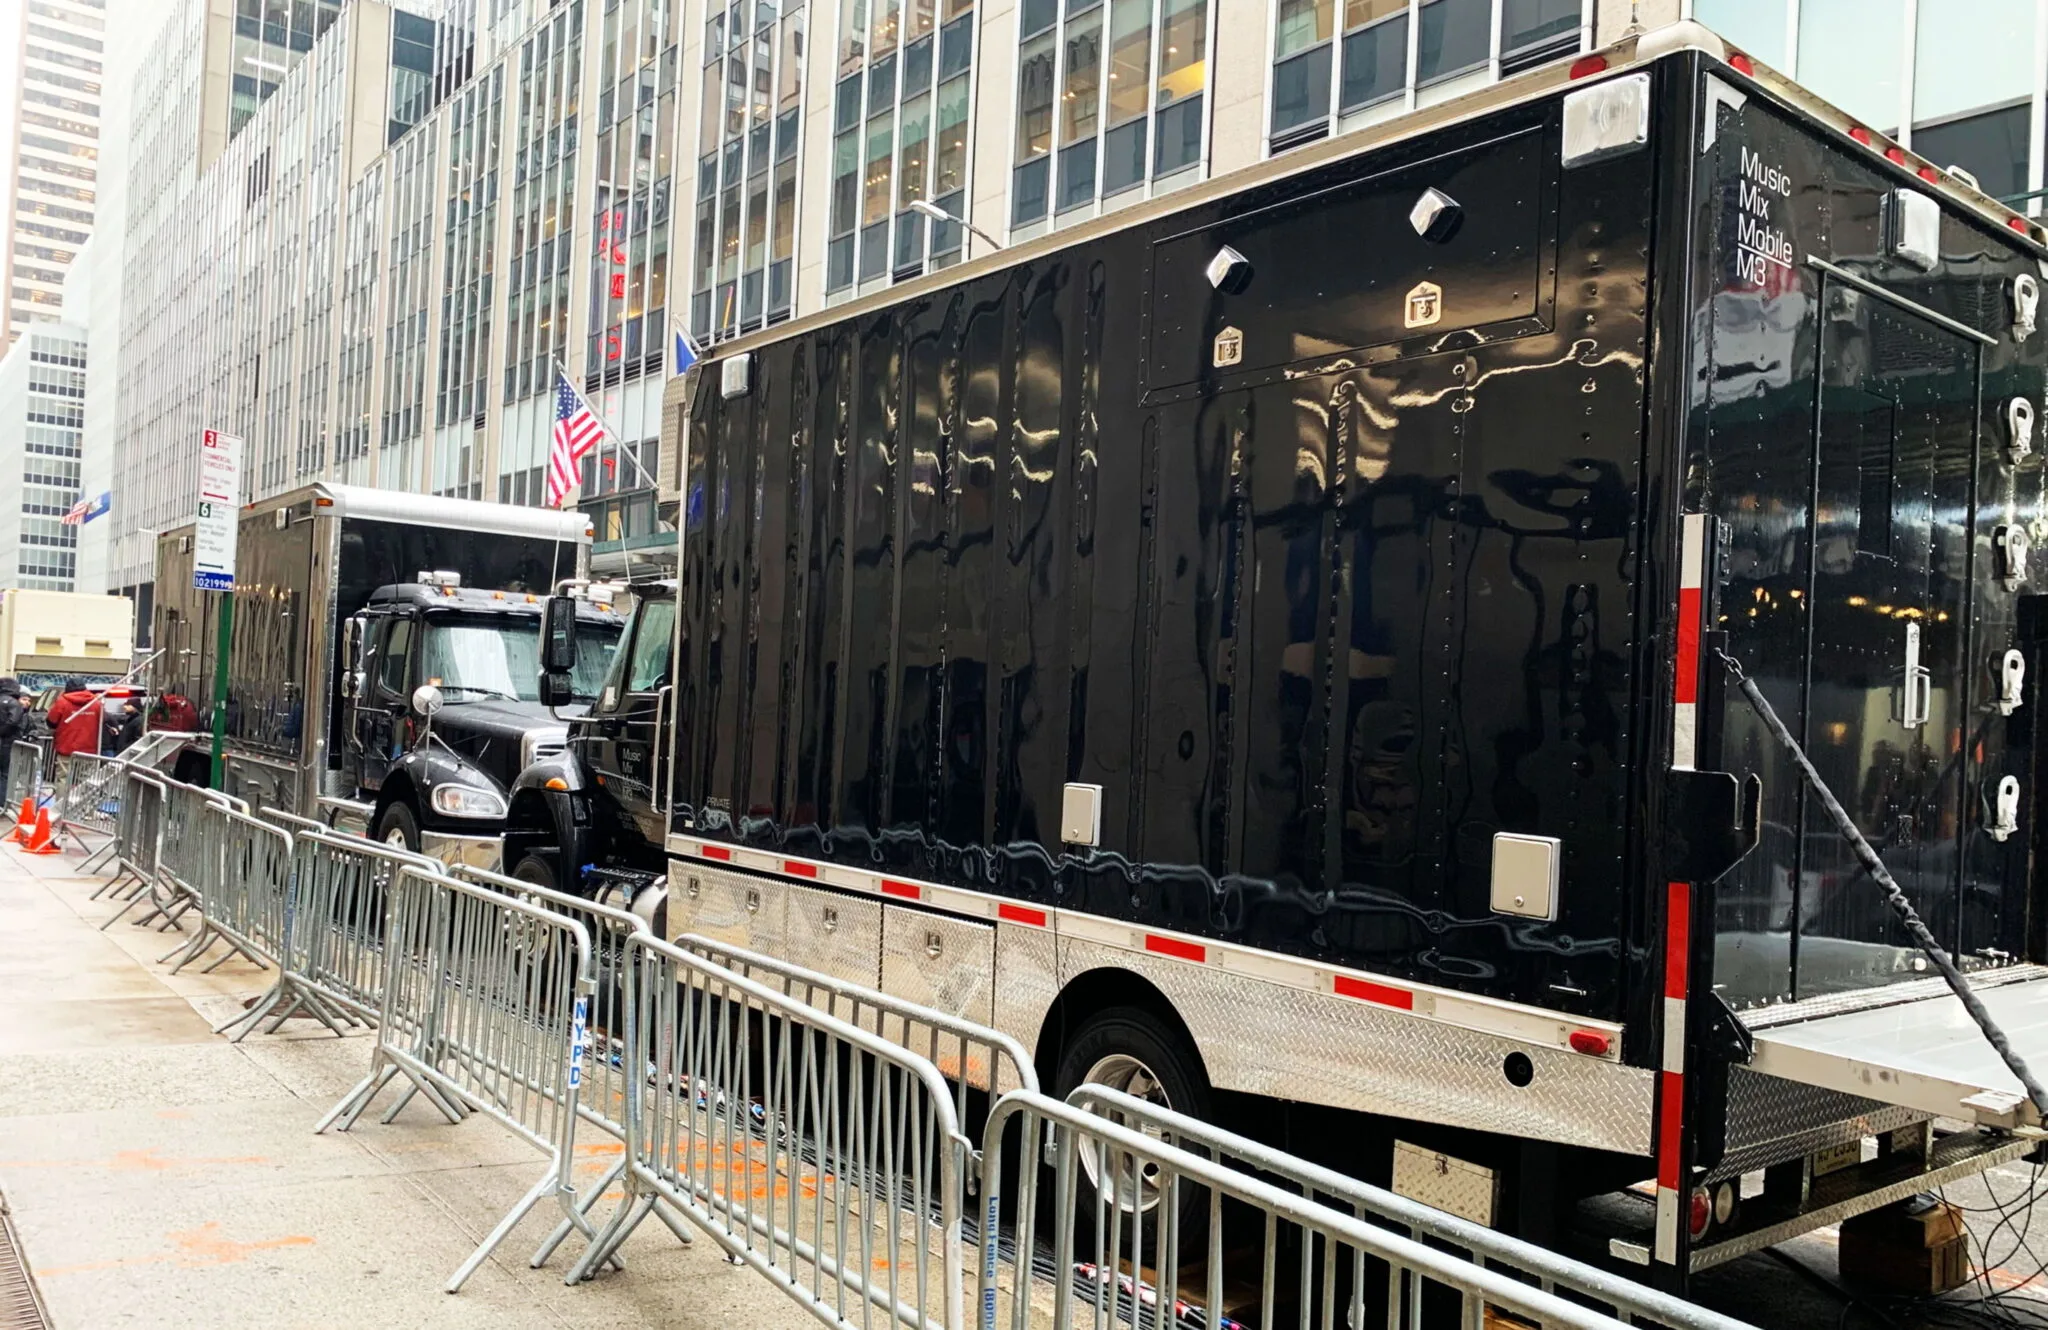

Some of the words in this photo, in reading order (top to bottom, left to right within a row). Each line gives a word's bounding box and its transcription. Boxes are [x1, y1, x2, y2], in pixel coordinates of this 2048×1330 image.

[1740, 145, 1791, 197] Music
[1739, 179, 1770, 221] Mix
[1737, 212, 1793, 264] Mobile
[1736, 248, 1766, 287] M3
[206, 431, 215, 448] 3
[200, 502, 209, 517] 6
[195, 577, 225, 589] 102199
[622, 747, 641, 762] Music
[622, 761, 633, 774] Mix
[570, 1001, 587, 1085] NYPD
[986, 1196, 998, 1232] Long
[985, 1234, 997, 1278] Fence
